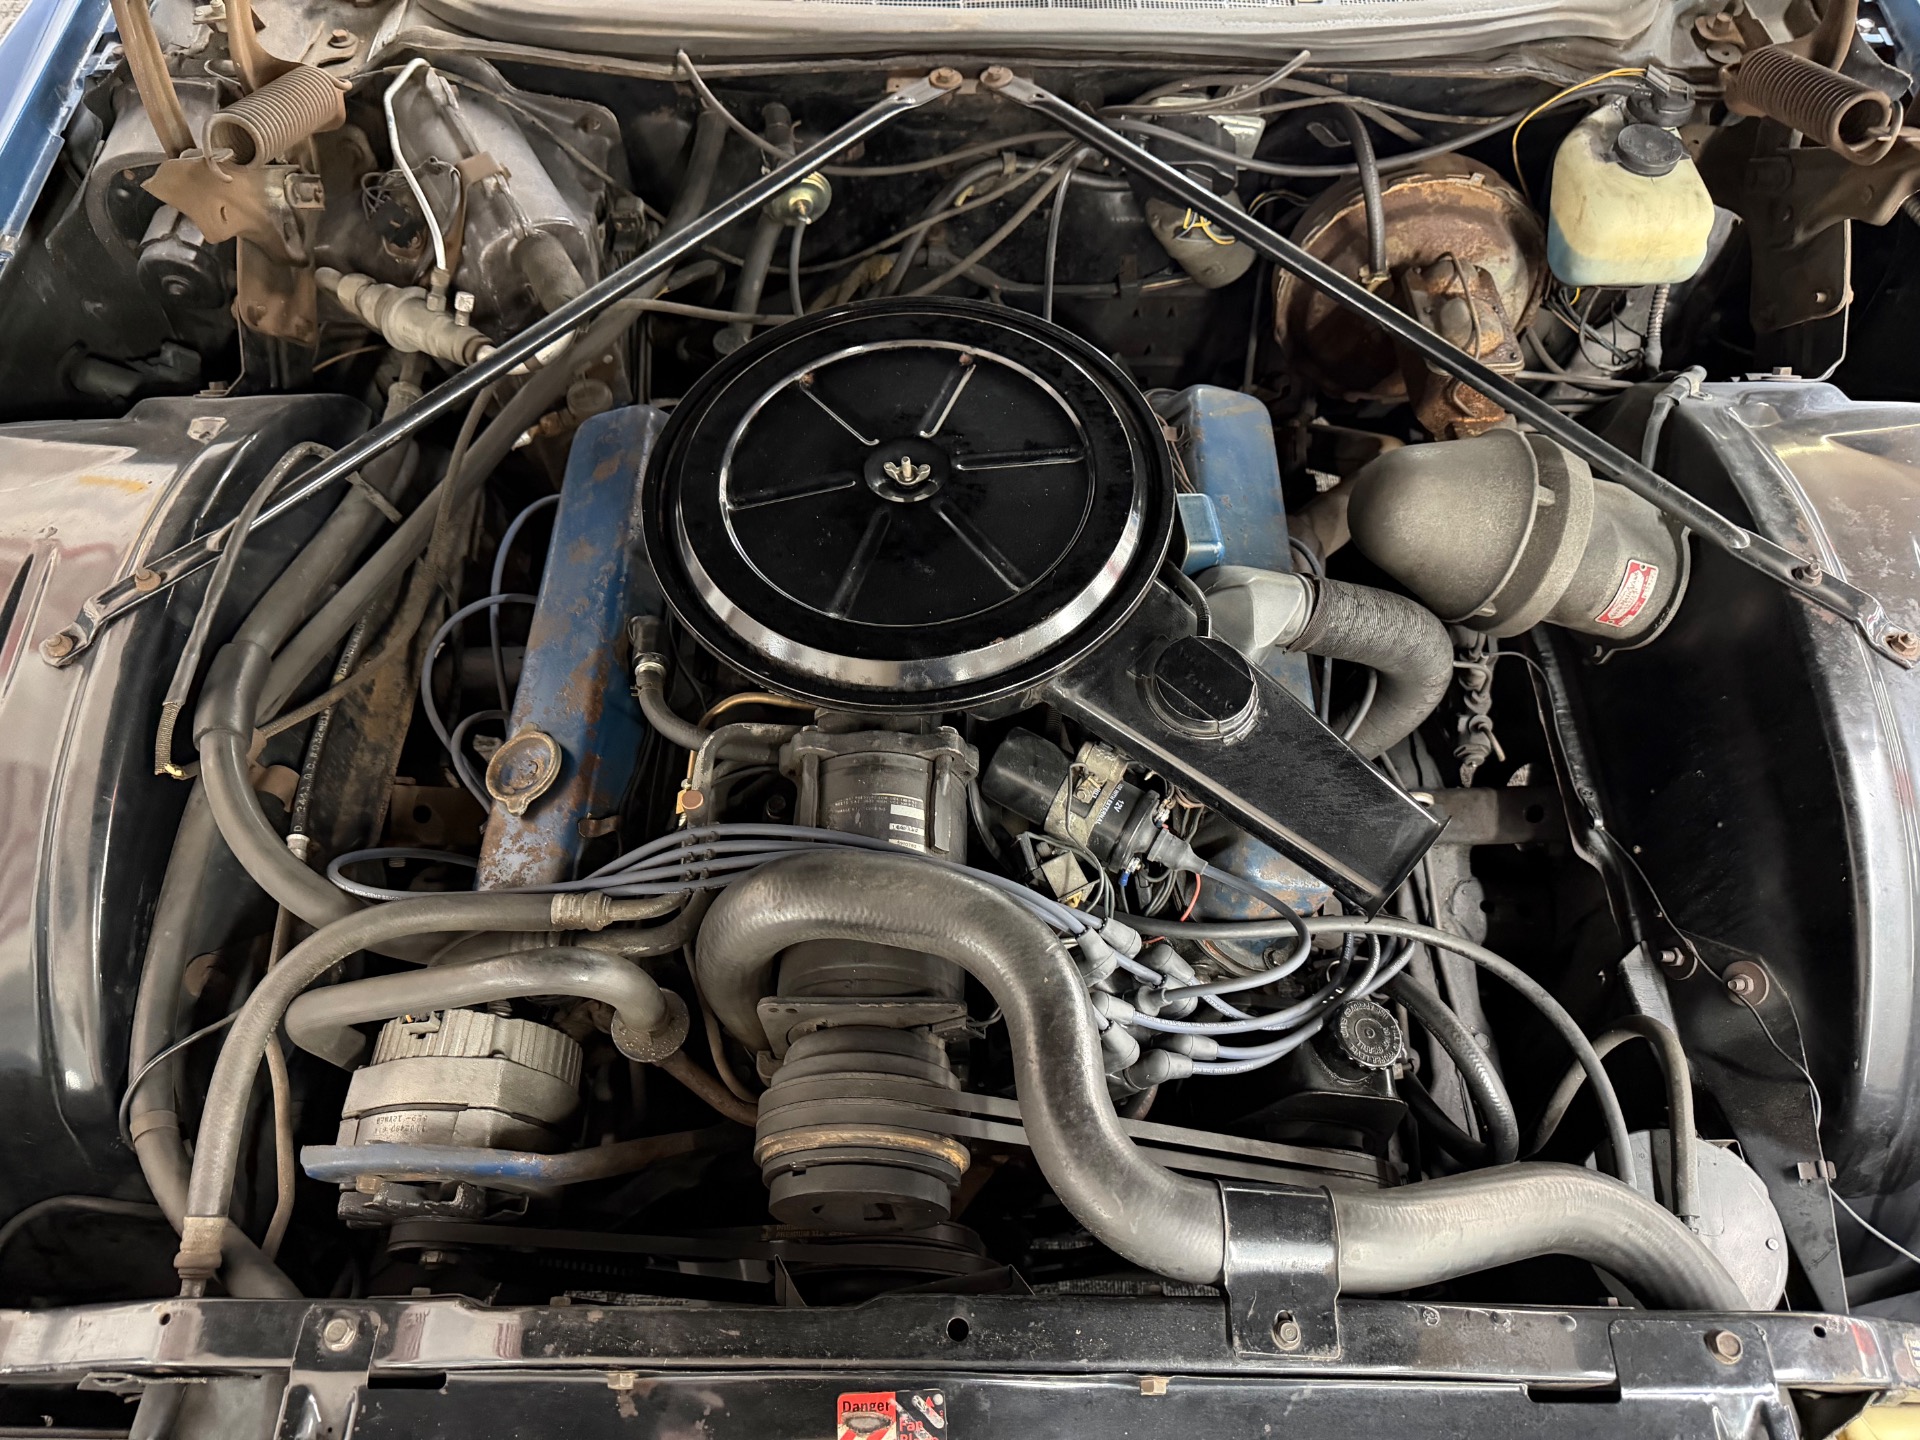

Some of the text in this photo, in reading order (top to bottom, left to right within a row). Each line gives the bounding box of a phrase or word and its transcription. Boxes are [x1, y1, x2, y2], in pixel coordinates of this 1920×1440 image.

[1096, 799, 1113, 825] EXTERNAL
[1113, 800, 1125, 812] 12V
[1349, 1043, 1370, 1062] LEVEL
[842, 1401, 891, 1412] Danger
[899, 1417, 924, 1432] Fan
